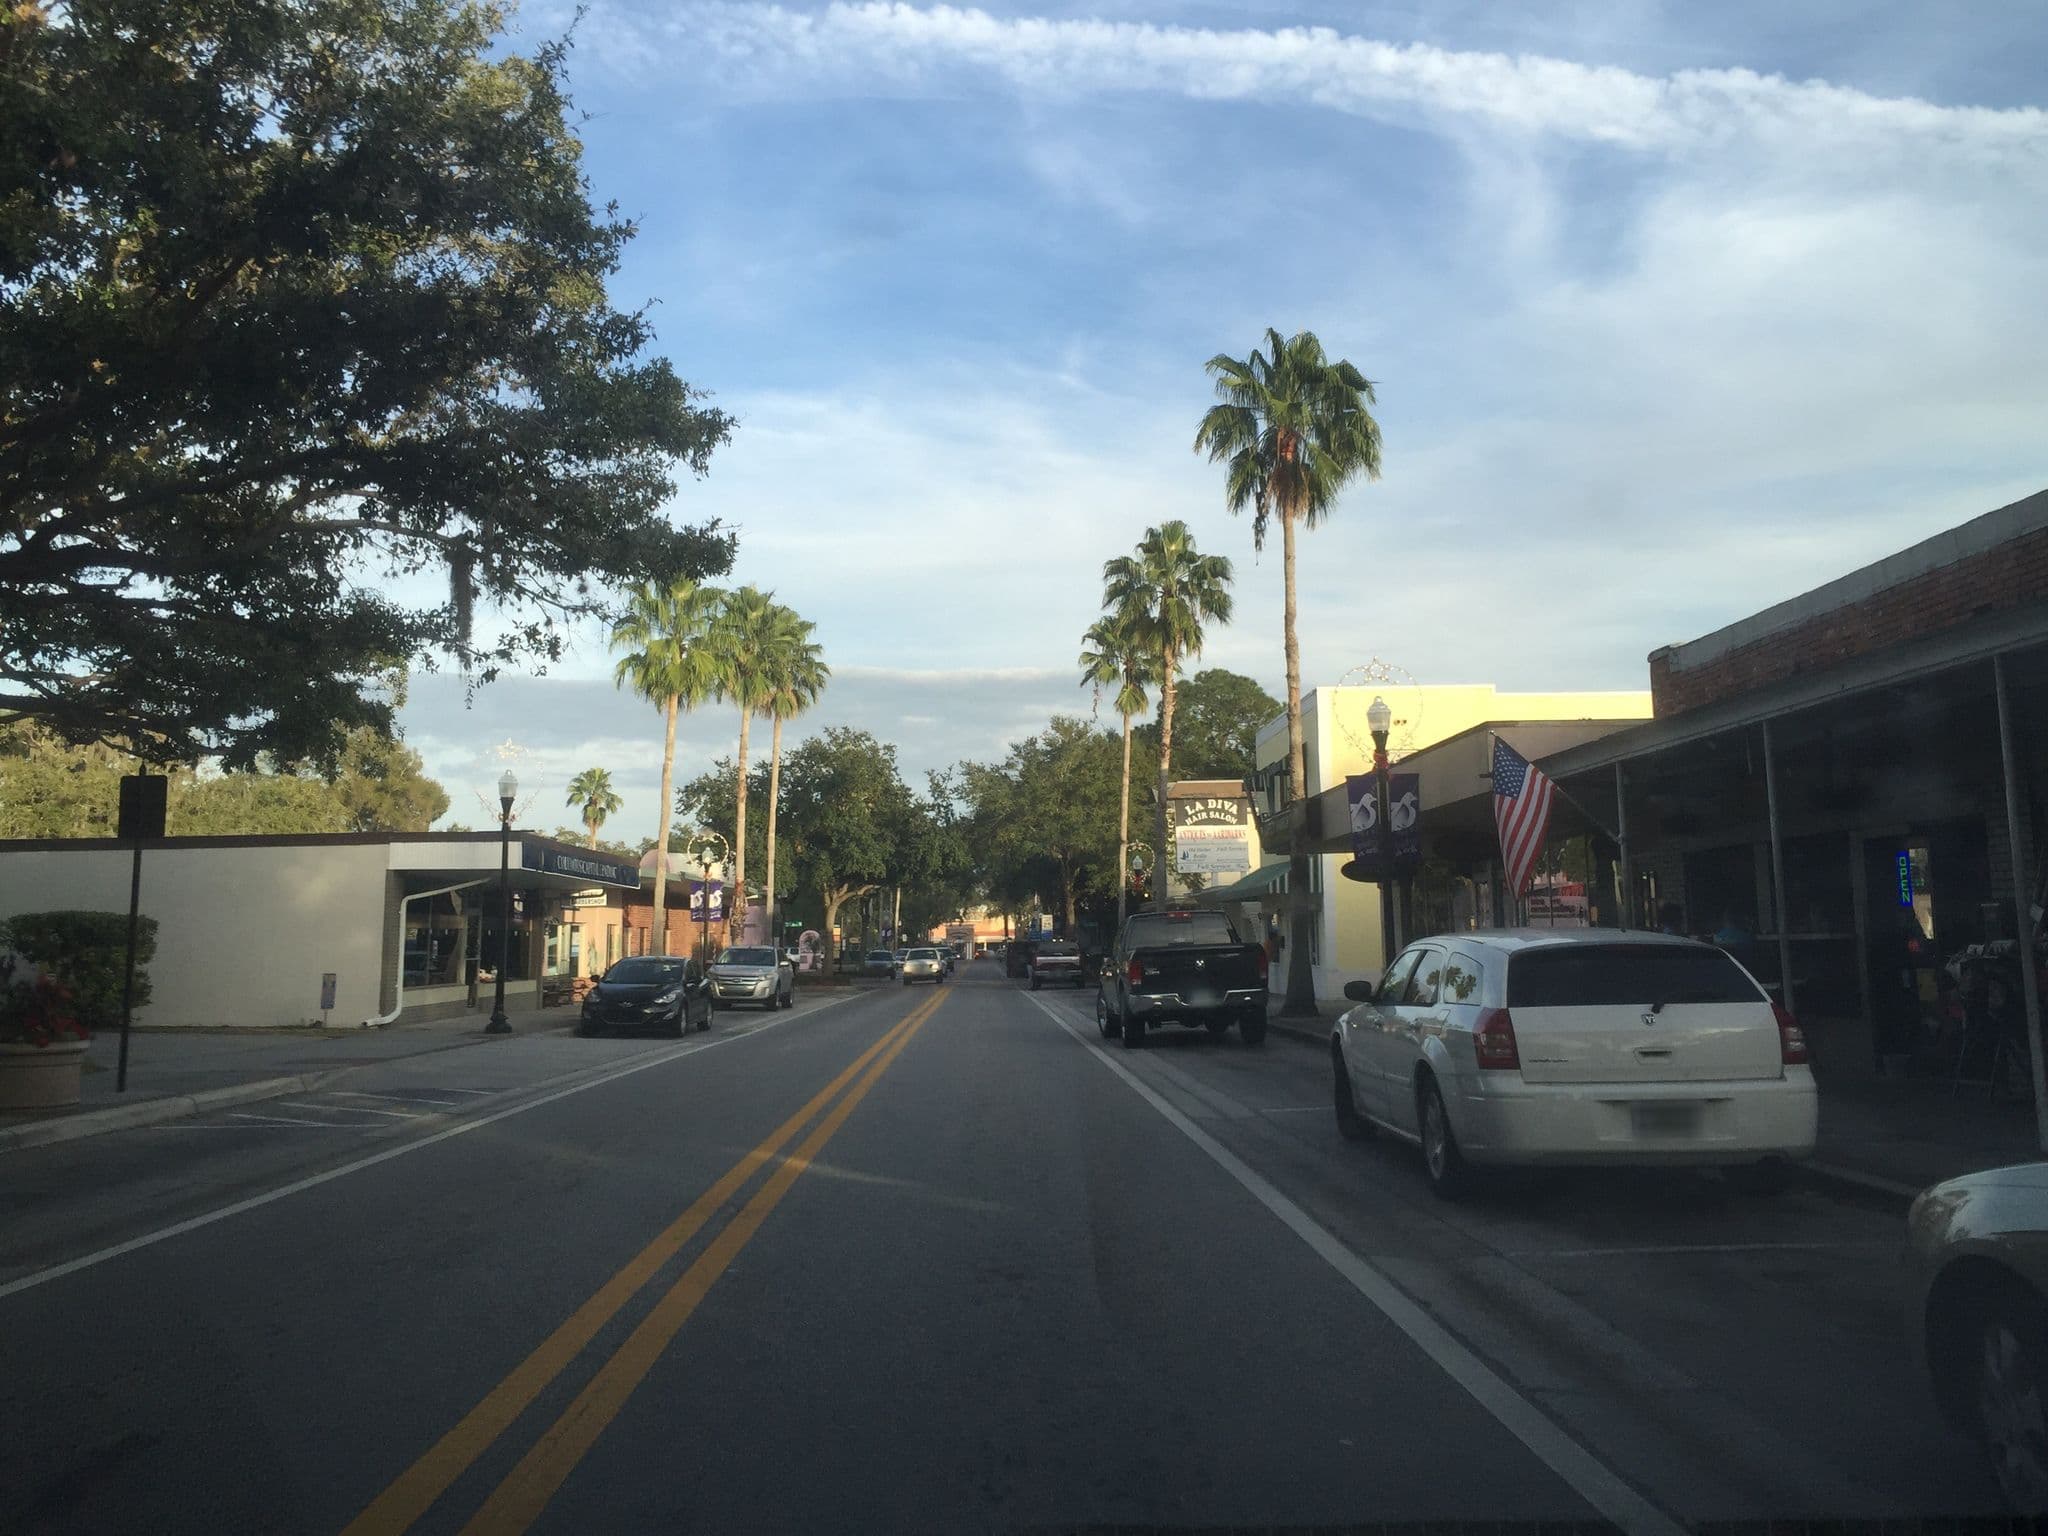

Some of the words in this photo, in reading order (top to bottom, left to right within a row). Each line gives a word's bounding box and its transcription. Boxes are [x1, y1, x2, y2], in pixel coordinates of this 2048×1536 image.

[1185, 801, 1204, 815] LA
[1207, 799, 1238, 815] DIVA
[1185, 812, 1208, 825] HAIR
[1209, 811, 1238, 824] SALON
[1899, 857, 1910, 903] OPEN
